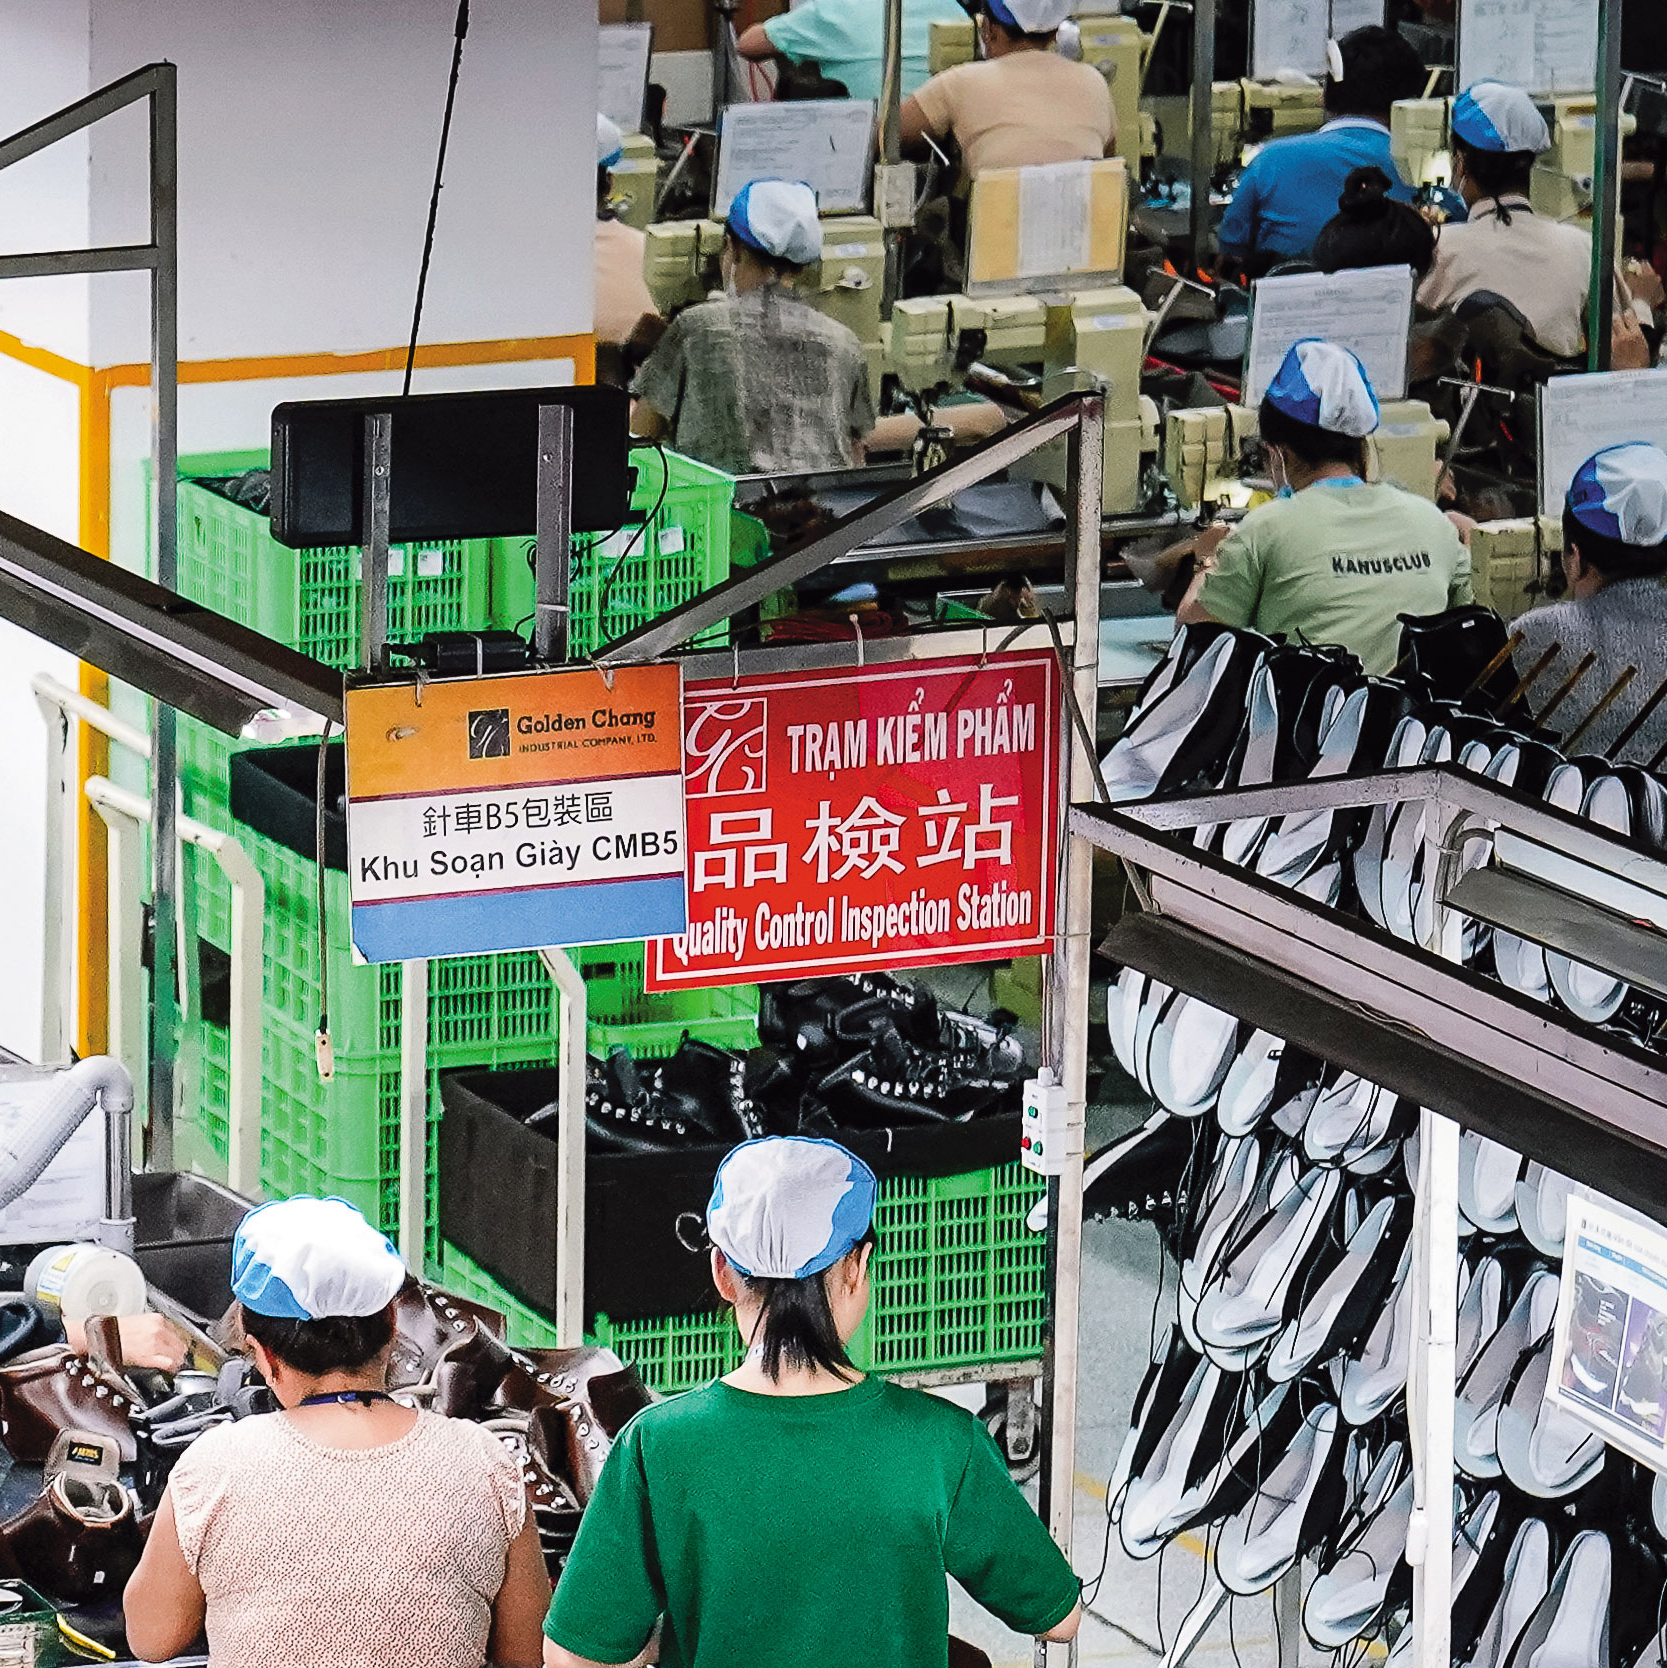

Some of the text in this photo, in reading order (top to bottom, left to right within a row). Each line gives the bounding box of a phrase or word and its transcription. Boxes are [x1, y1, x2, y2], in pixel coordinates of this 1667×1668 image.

[516, 708, 657, 735] Golden Chang
[519, 740, 579, 753] INDUSTRIAL
[787, 678, 1035, 781] TRẠM KIỂM PHẨM
[422, 791, 613, 838] 針車B5包裝區
[693, 783, 1020, 892] 品檢站
[360, 829, 679, 883] Khu Soạn Giày CMB5
[755, 895, 834, 951] Control
[841, 880, 950, 948] Inspection
[957, 881, 1032, 931] Station
